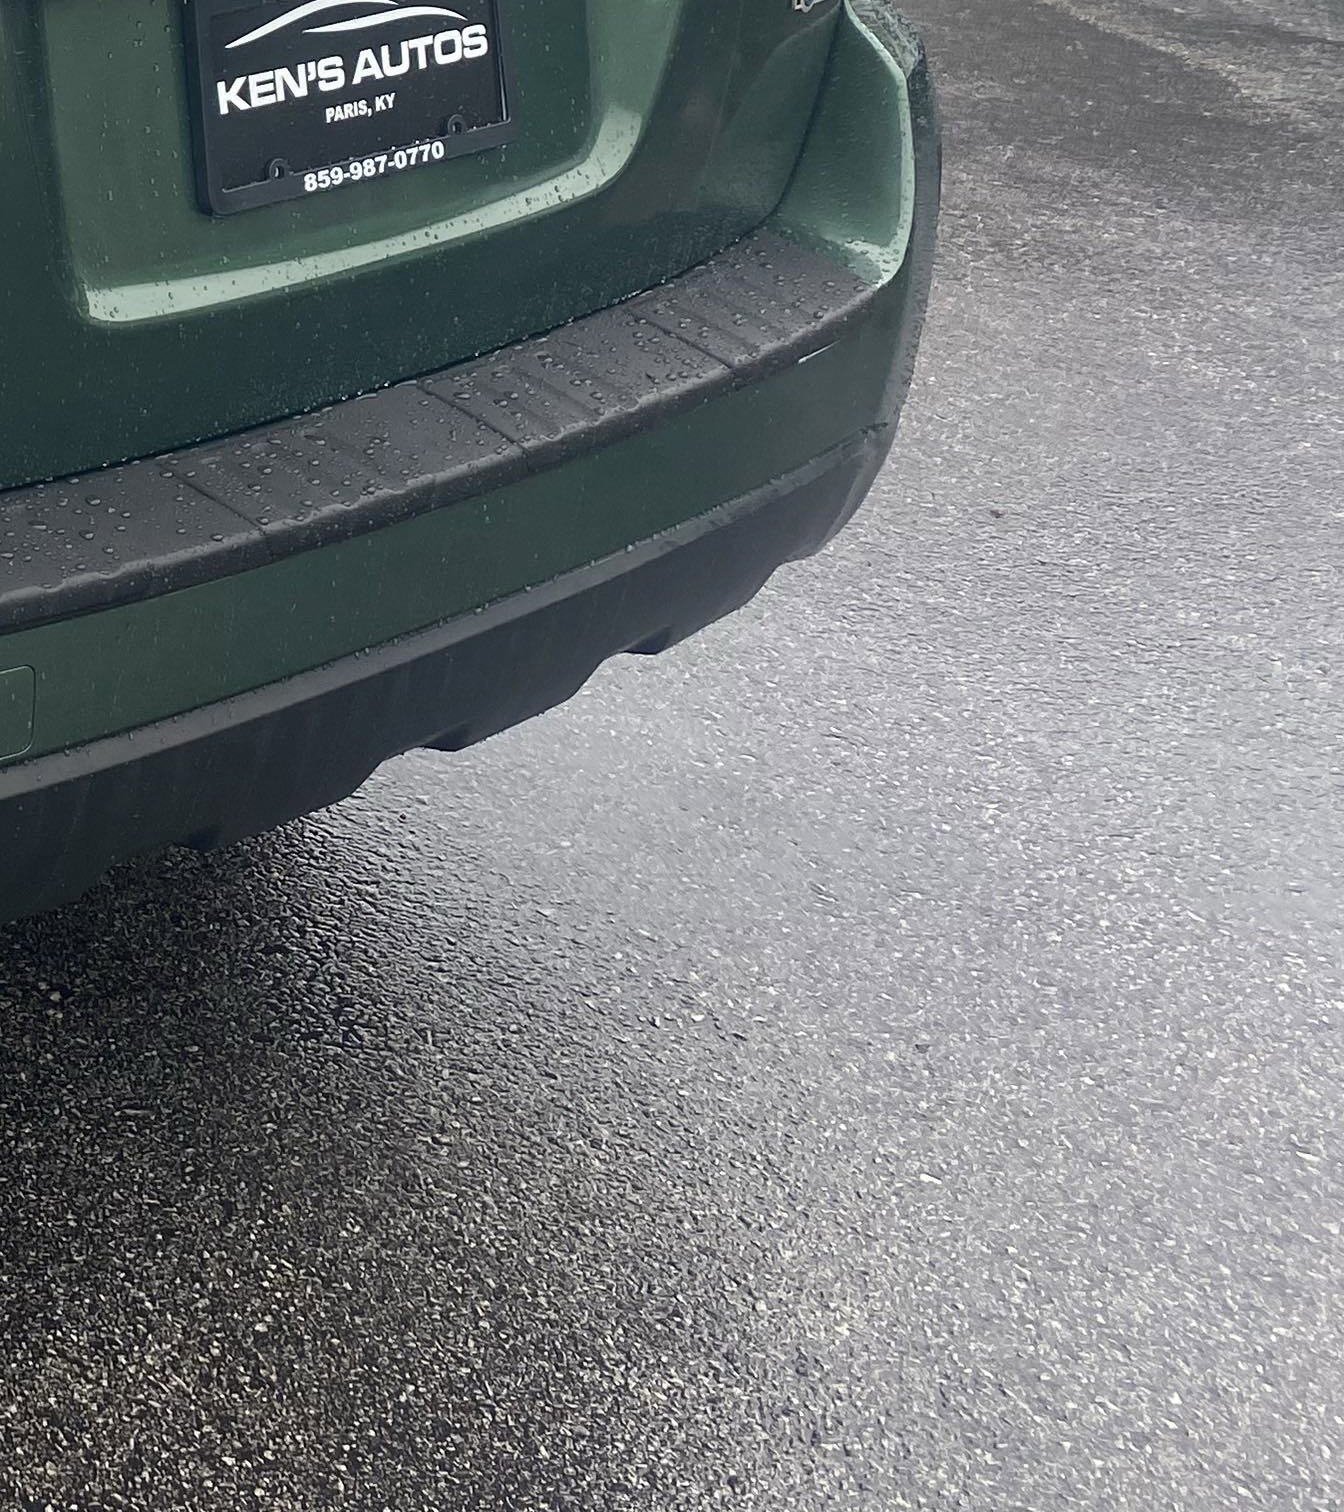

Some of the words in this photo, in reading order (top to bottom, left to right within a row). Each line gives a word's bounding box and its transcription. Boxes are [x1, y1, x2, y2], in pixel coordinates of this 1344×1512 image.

[216, 55, 346, 115] KEN'S
[352, 24, 489, 85] AUTOS
[325, 98, 373, 123] PARIS,
[375, 92, 396, 111] KY
[303, 140, 445, 192] 859-987-0770
